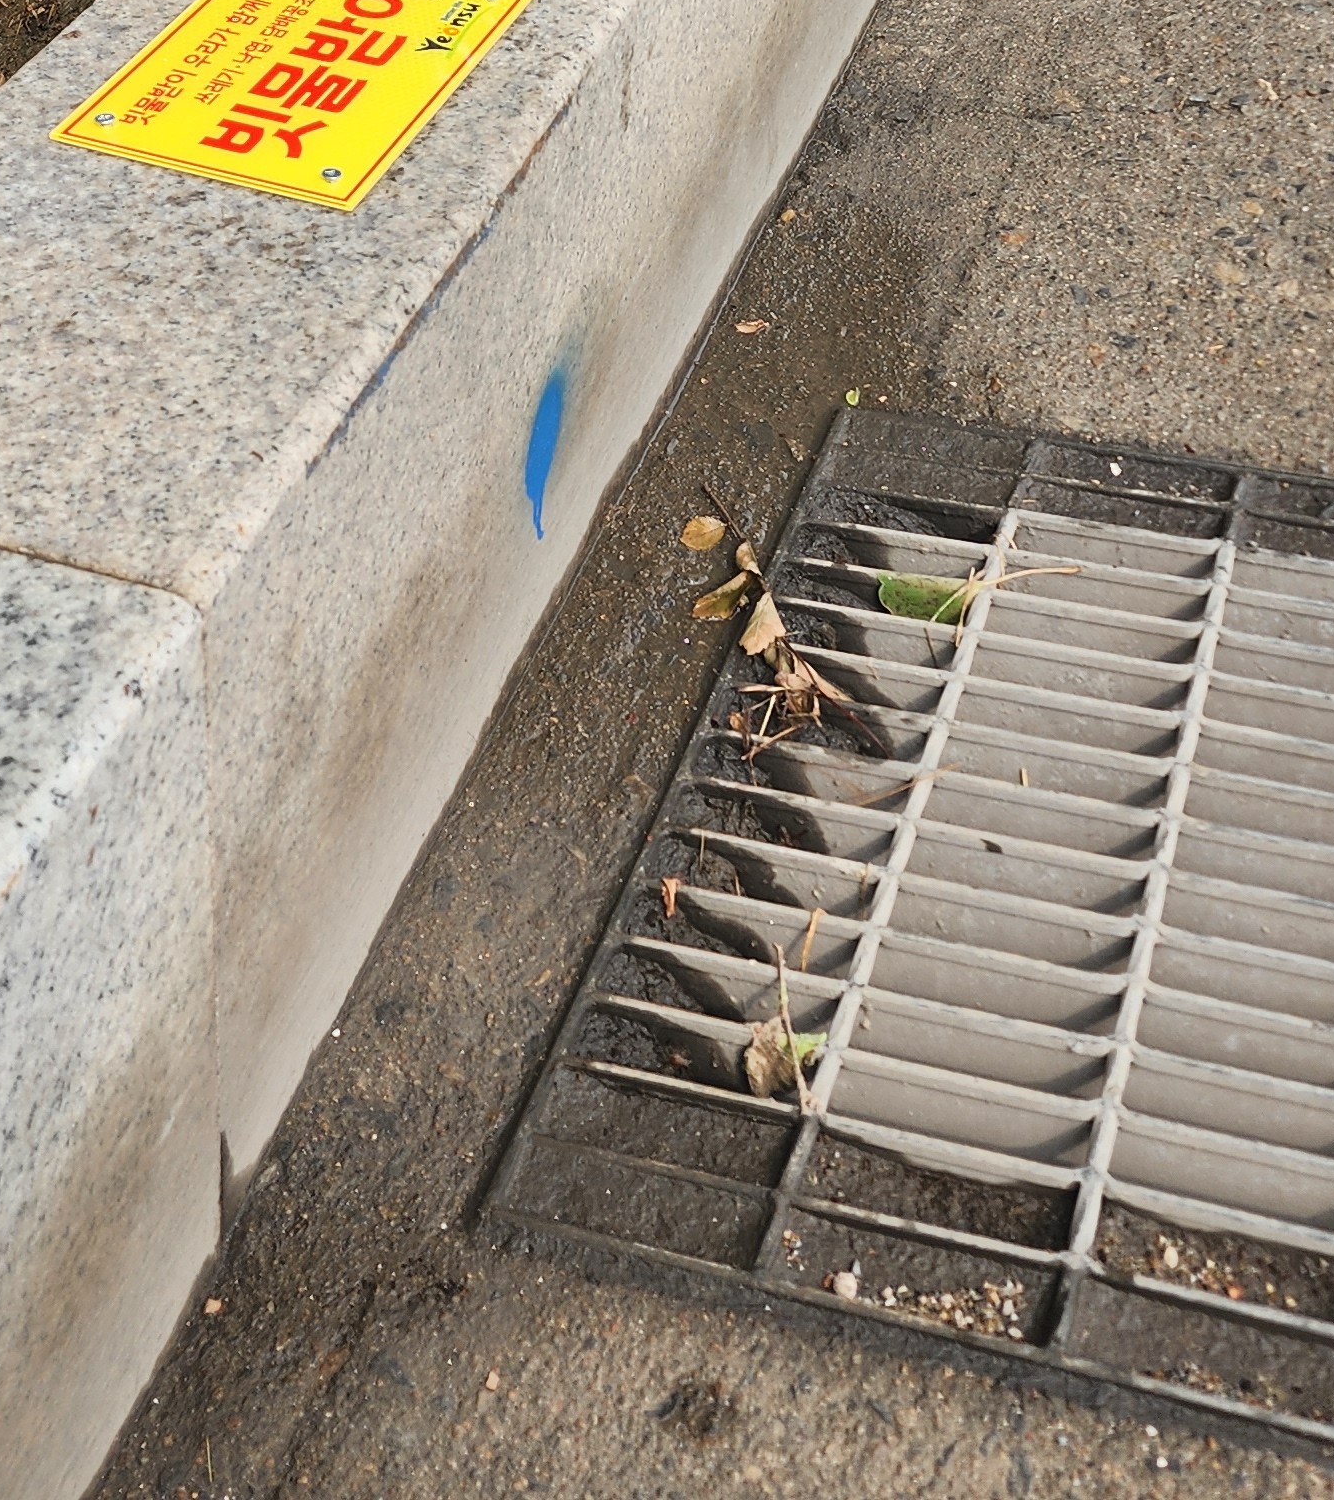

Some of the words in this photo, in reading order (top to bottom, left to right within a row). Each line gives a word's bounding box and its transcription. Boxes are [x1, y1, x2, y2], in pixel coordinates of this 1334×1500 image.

[414, 2, 482, 52] Yeonsu
[118, 67, 197, 126] 빗물받이
[183, 27, 240, 68] 우리가
